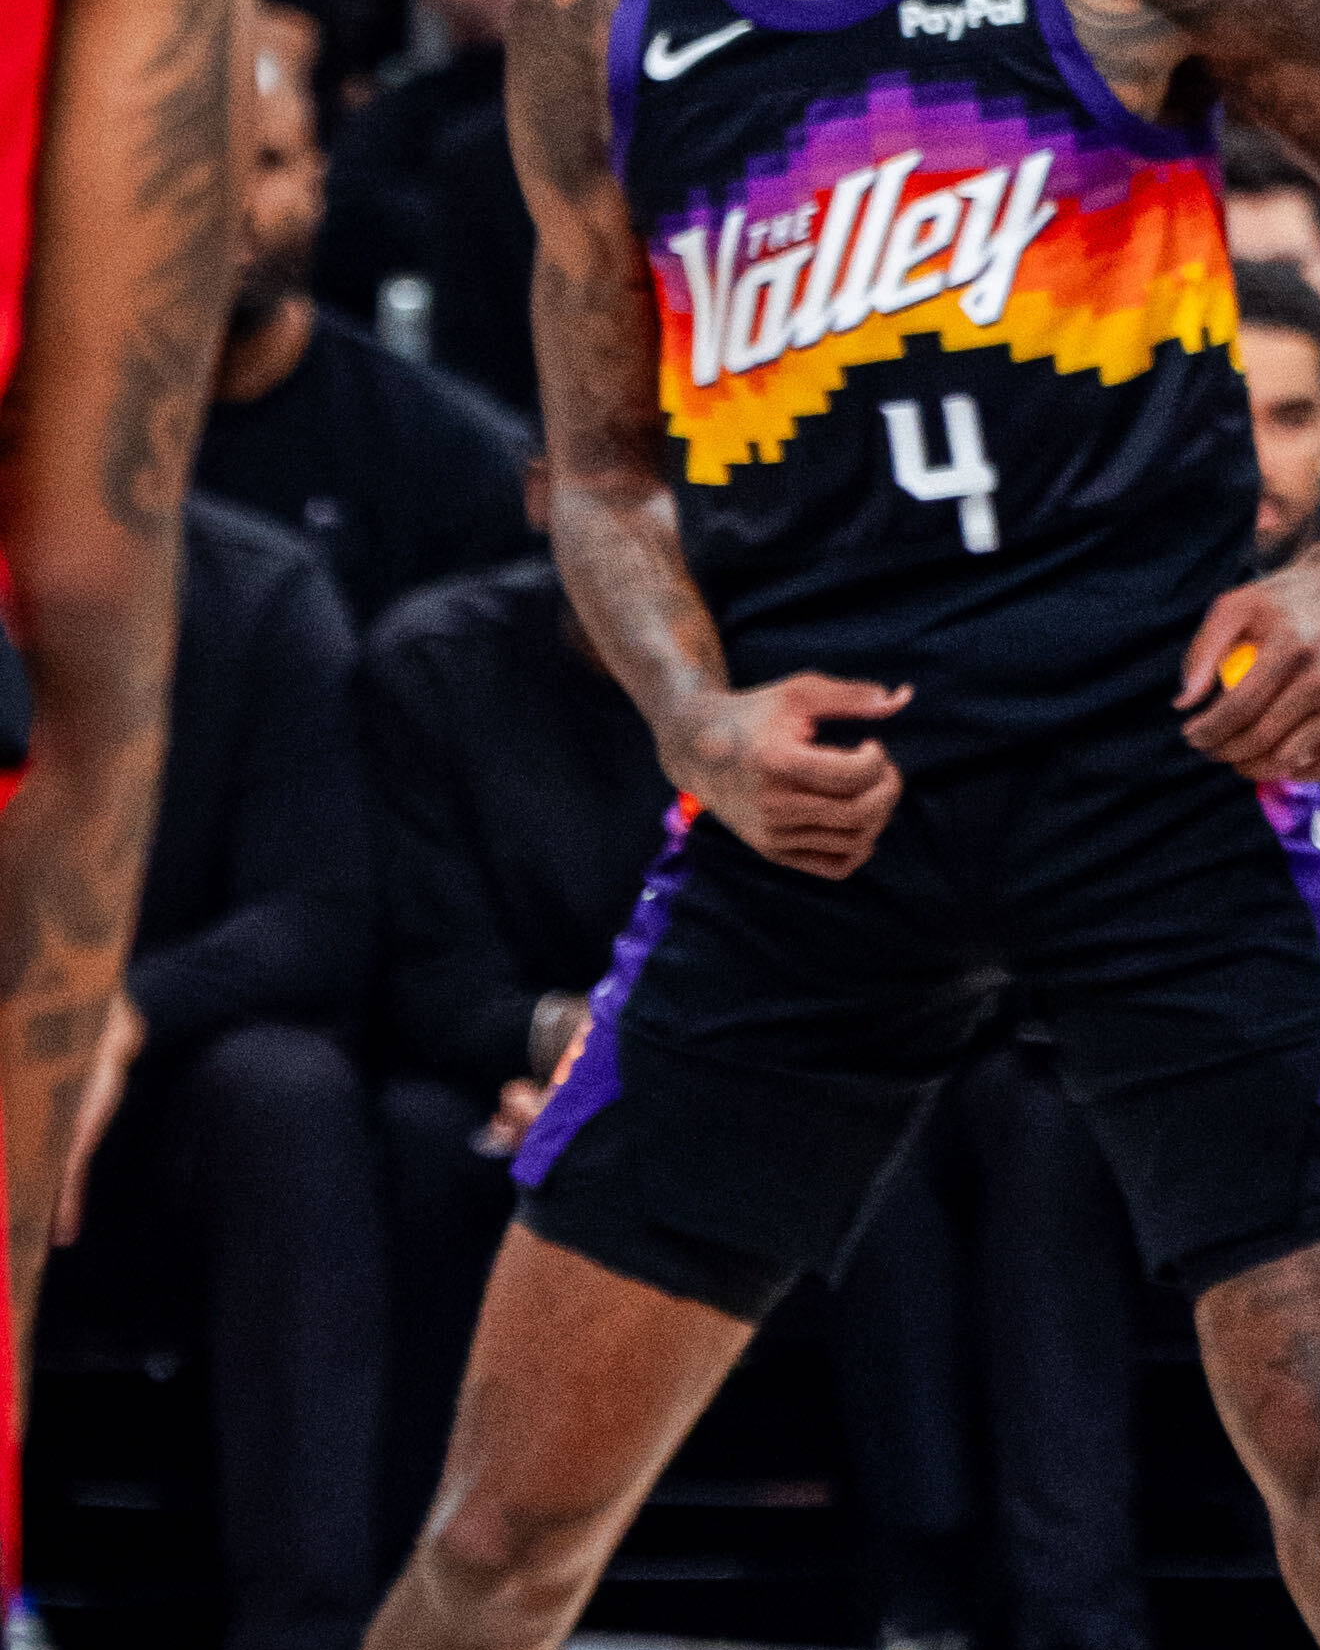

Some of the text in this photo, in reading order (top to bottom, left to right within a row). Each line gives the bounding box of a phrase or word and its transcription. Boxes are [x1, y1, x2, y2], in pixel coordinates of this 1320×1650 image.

[668, 148, 1059, 388] Valley
[745, 200, 819, 260] THE
[878, 391, 1001, 556] 4
